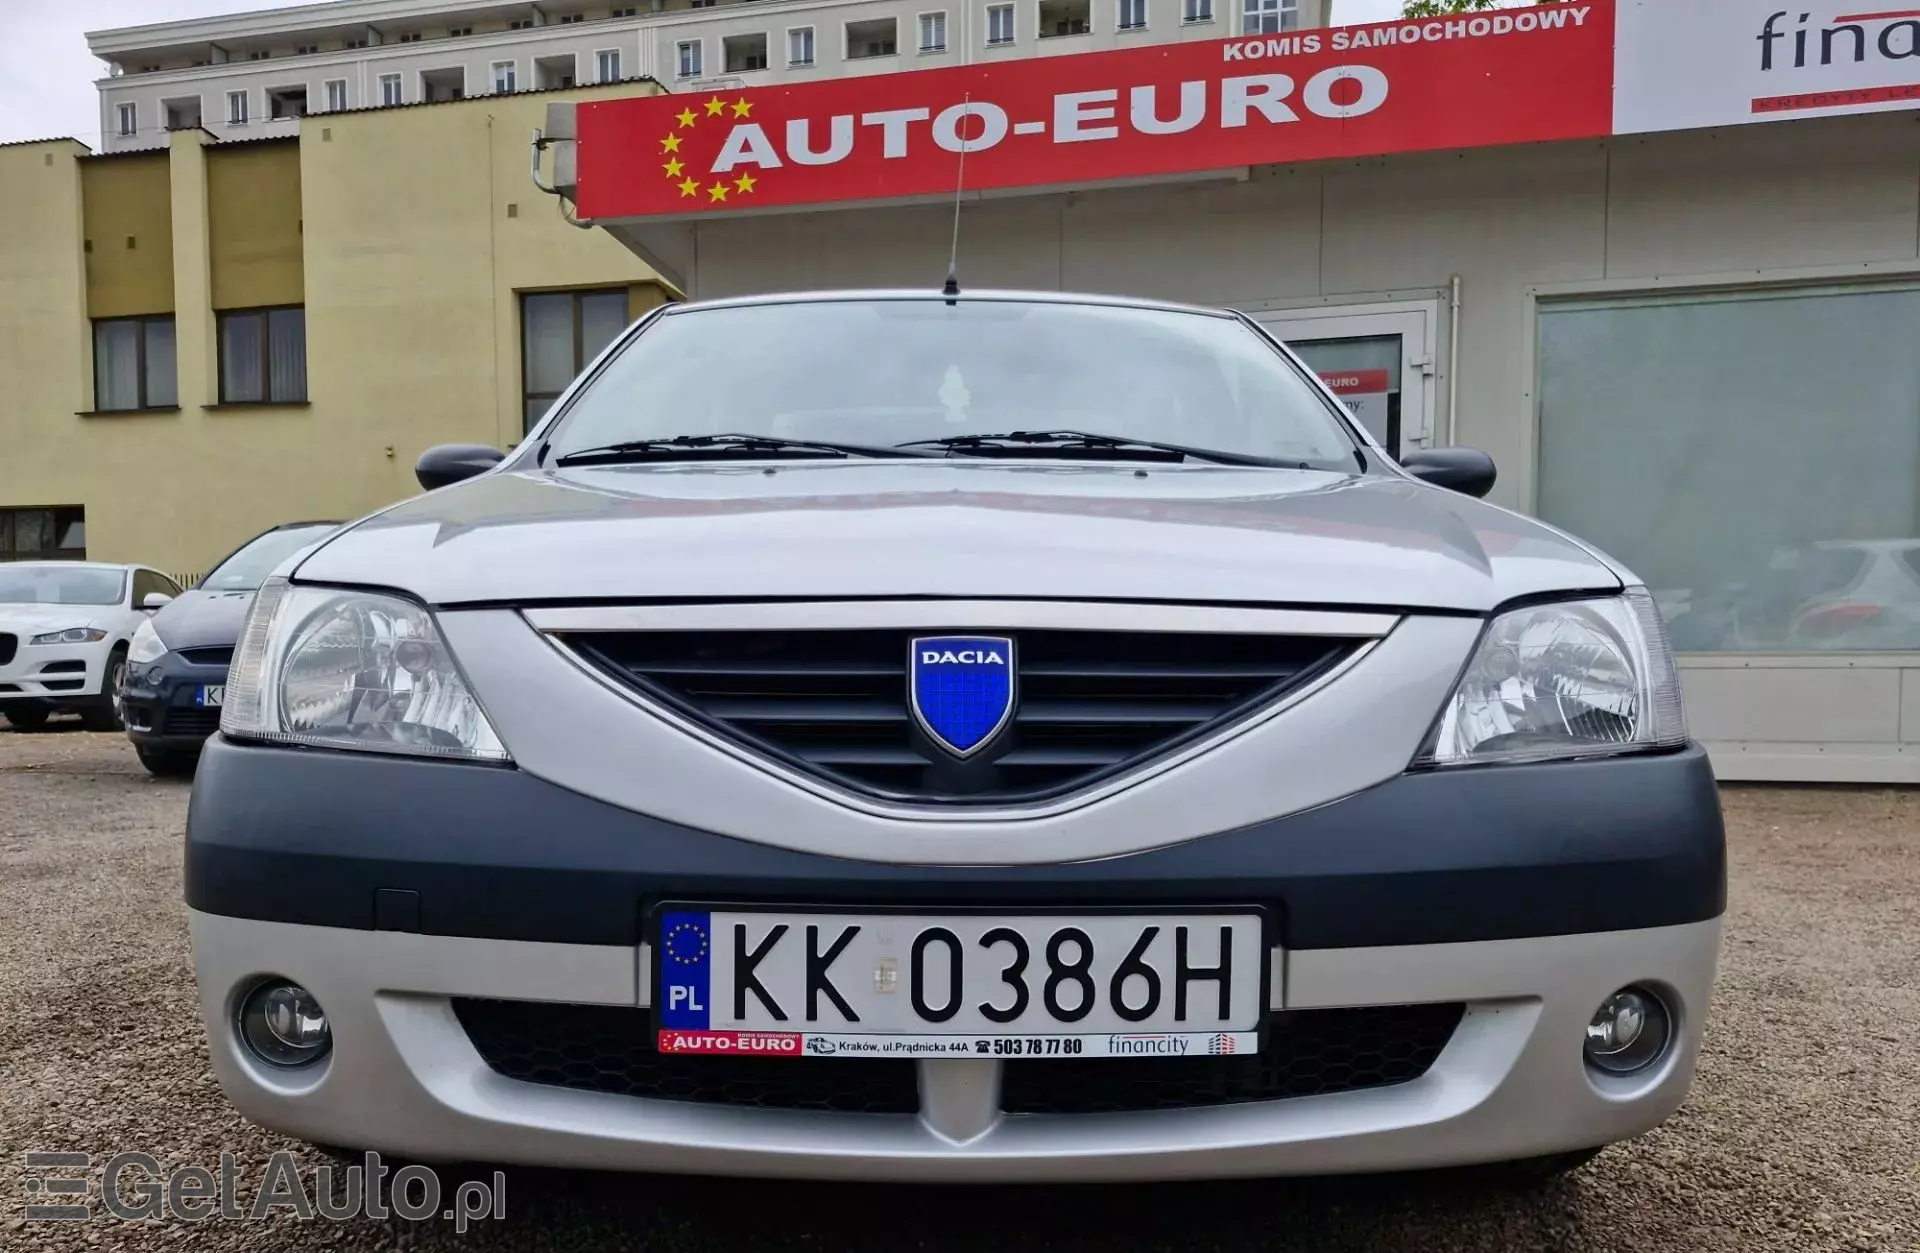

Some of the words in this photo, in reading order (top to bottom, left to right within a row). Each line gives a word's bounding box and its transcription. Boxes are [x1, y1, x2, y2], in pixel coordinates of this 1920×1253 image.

[1223, 35, 1321, 61] KOMIS
[1331, 7, 1591, 51] SAMOCHODOWY
[710, 64, 1389, 174] AUTO-EURO
[922, 650, 1005, 665] DACIA
[733, 924, 862, 1022] KK
[911, 926, 1233, 1023] 0386H
[669, 985, 703, 1011] PL
[673, 1036, 796, 1051] AUTO-EURO
[839, 1041, 880, 1052] Kraków,
[883, 1042, 946, 1054] ul.Prądnicka
[949, 1043, 969, 1052] 44A
[994, 1039, 1022, 1054] 503
[1025, 1039, 1043, 1054] 78
[1045, 1039, 1061, 1054] 77
[1063, 1039, 1082, 1054] 80
[1109, 1034, 1189, 1056] financity
